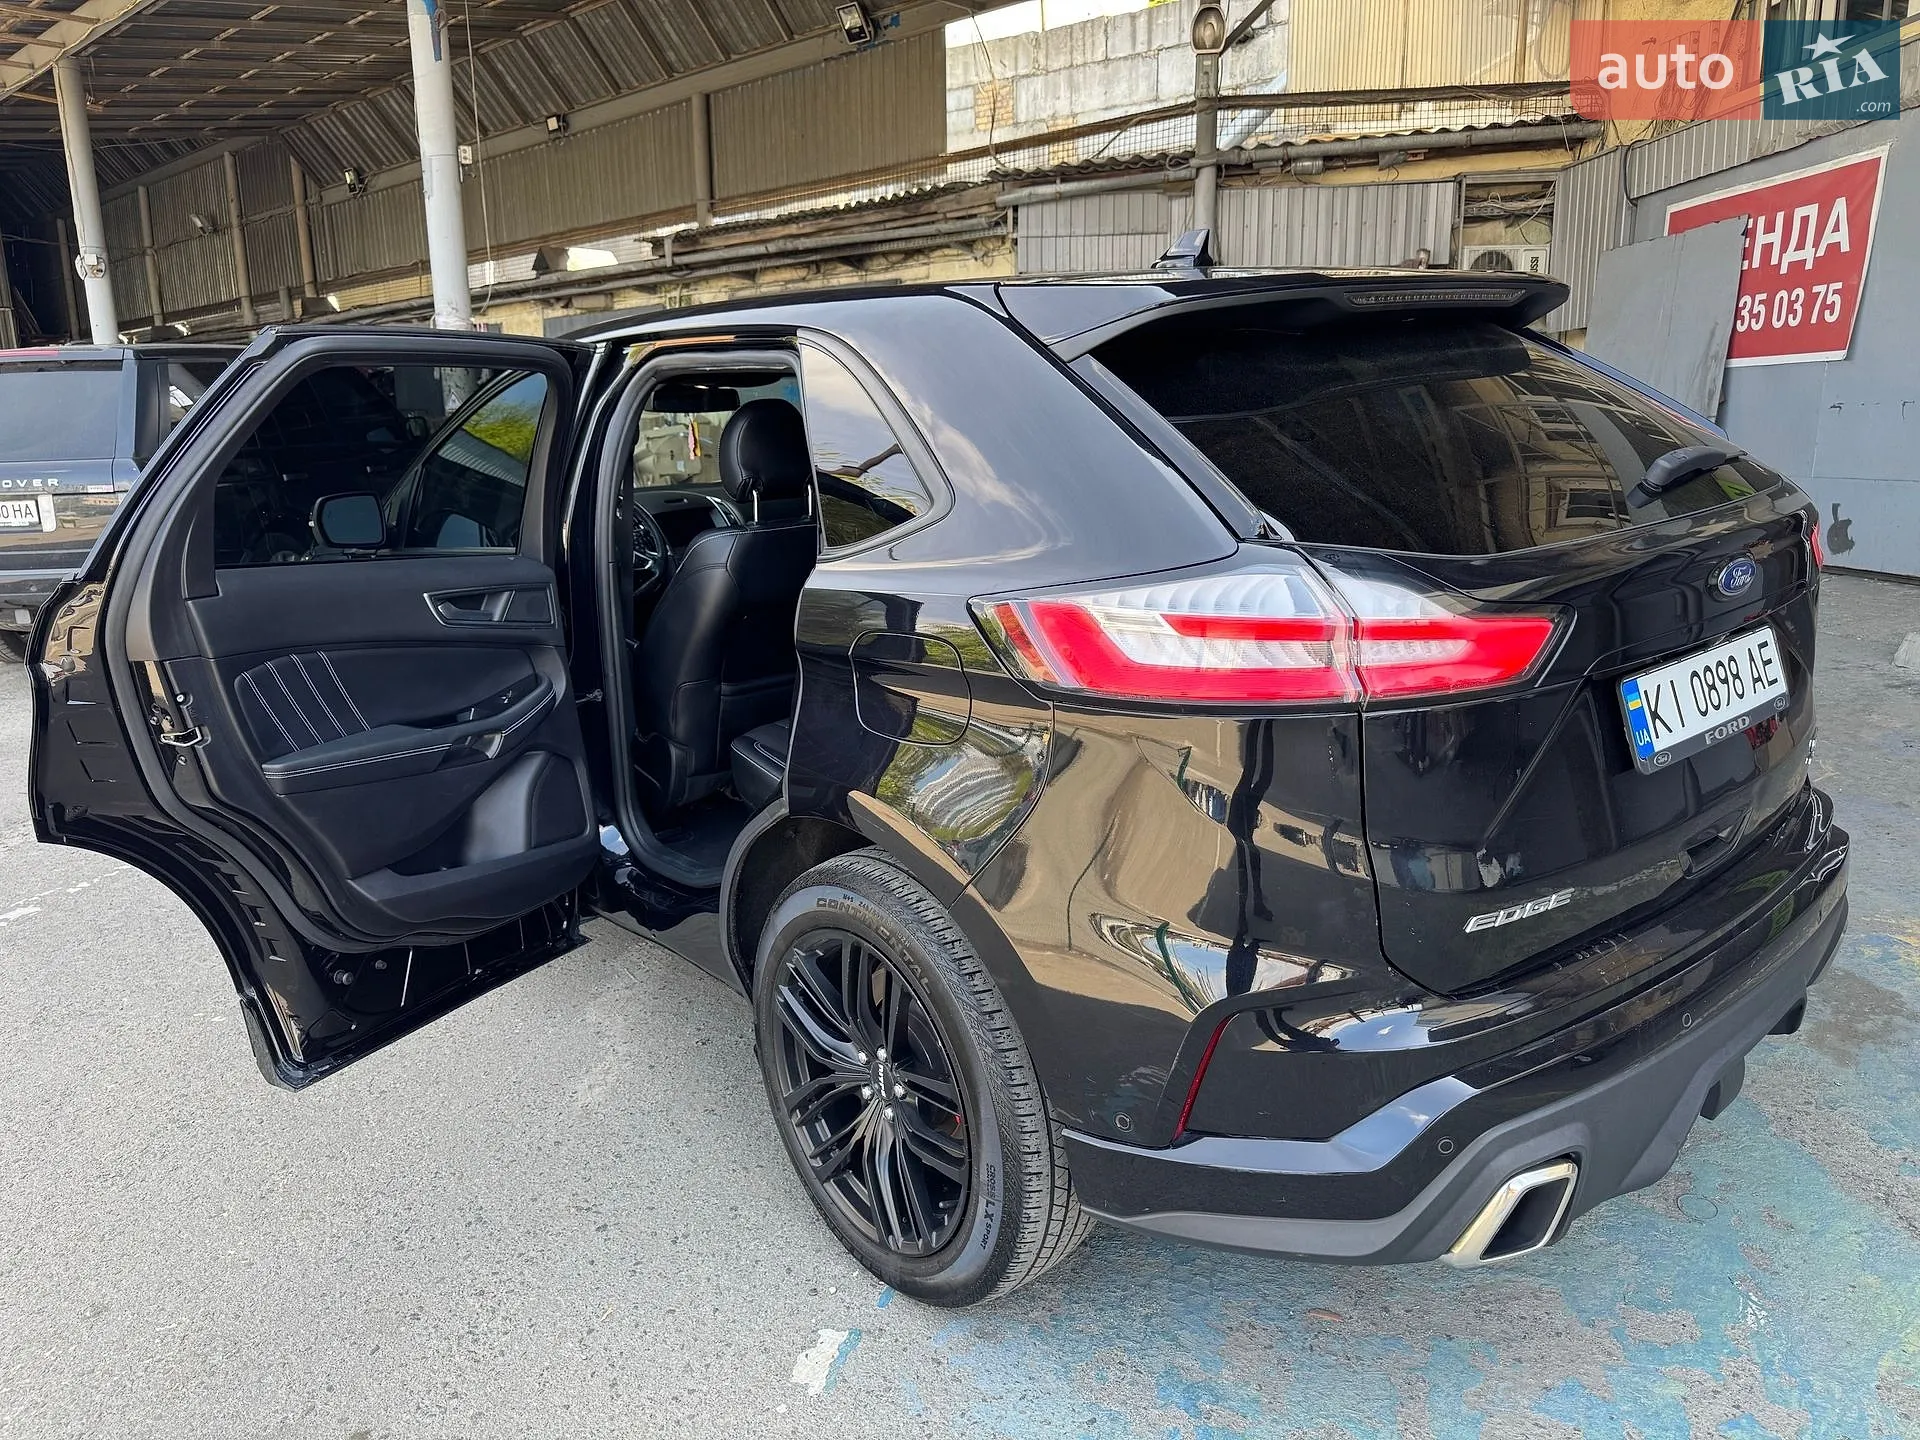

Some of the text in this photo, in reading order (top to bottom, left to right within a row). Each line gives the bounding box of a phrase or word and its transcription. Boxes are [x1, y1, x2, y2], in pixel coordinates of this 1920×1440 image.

[1736, 281, 1843, 332] 35 03 75
[0, 503, 35, 519] 0 HA
[1643, 640, 1779, 740] KI 0898 AE
[1635, 731, 1651, 746] UA
[1704, 715, 1750, 745] FORD
[1462, 887, 1575, 933] EDGE
[980, 1221, 993, 1250] SPORT
